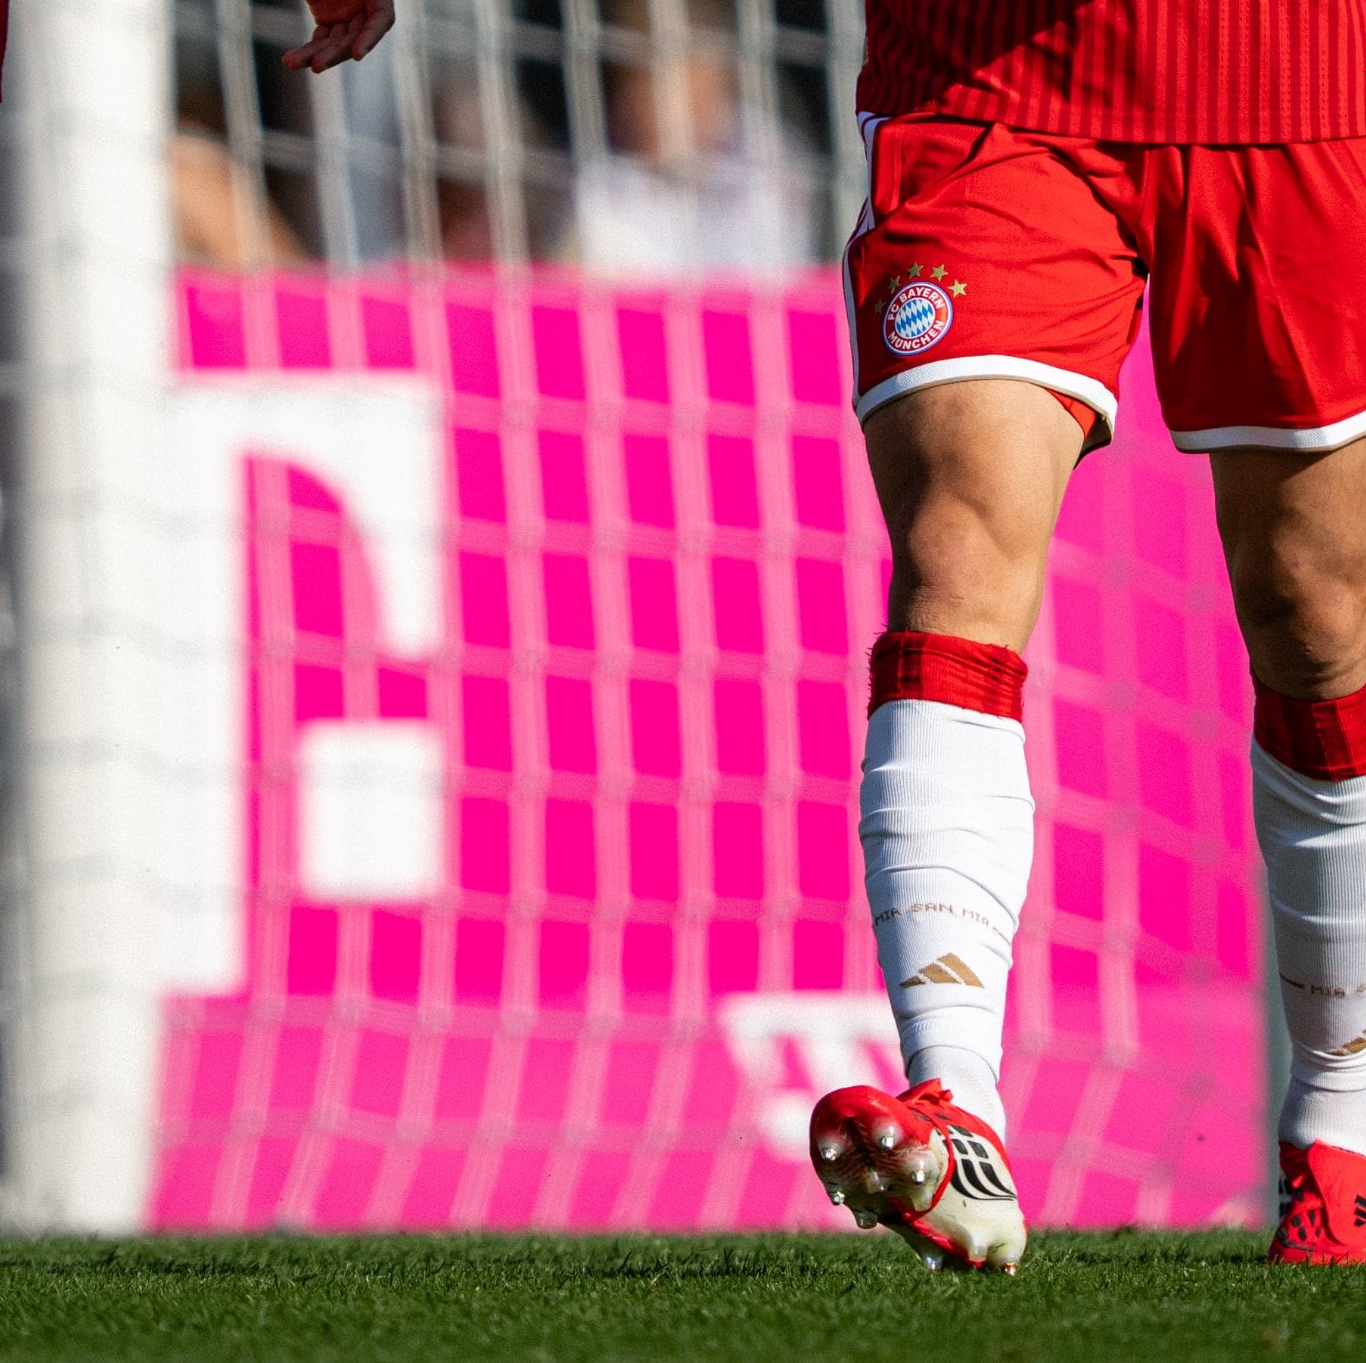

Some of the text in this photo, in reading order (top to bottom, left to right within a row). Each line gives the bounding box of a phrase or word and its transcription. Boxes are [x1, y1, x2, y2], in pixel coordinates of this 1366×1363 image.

[887, 286, 945, 321] FC BAYERN
[875, 902, 989, 927] MIA SAN MIA
[1311, 985, 1345, 997] MIA
